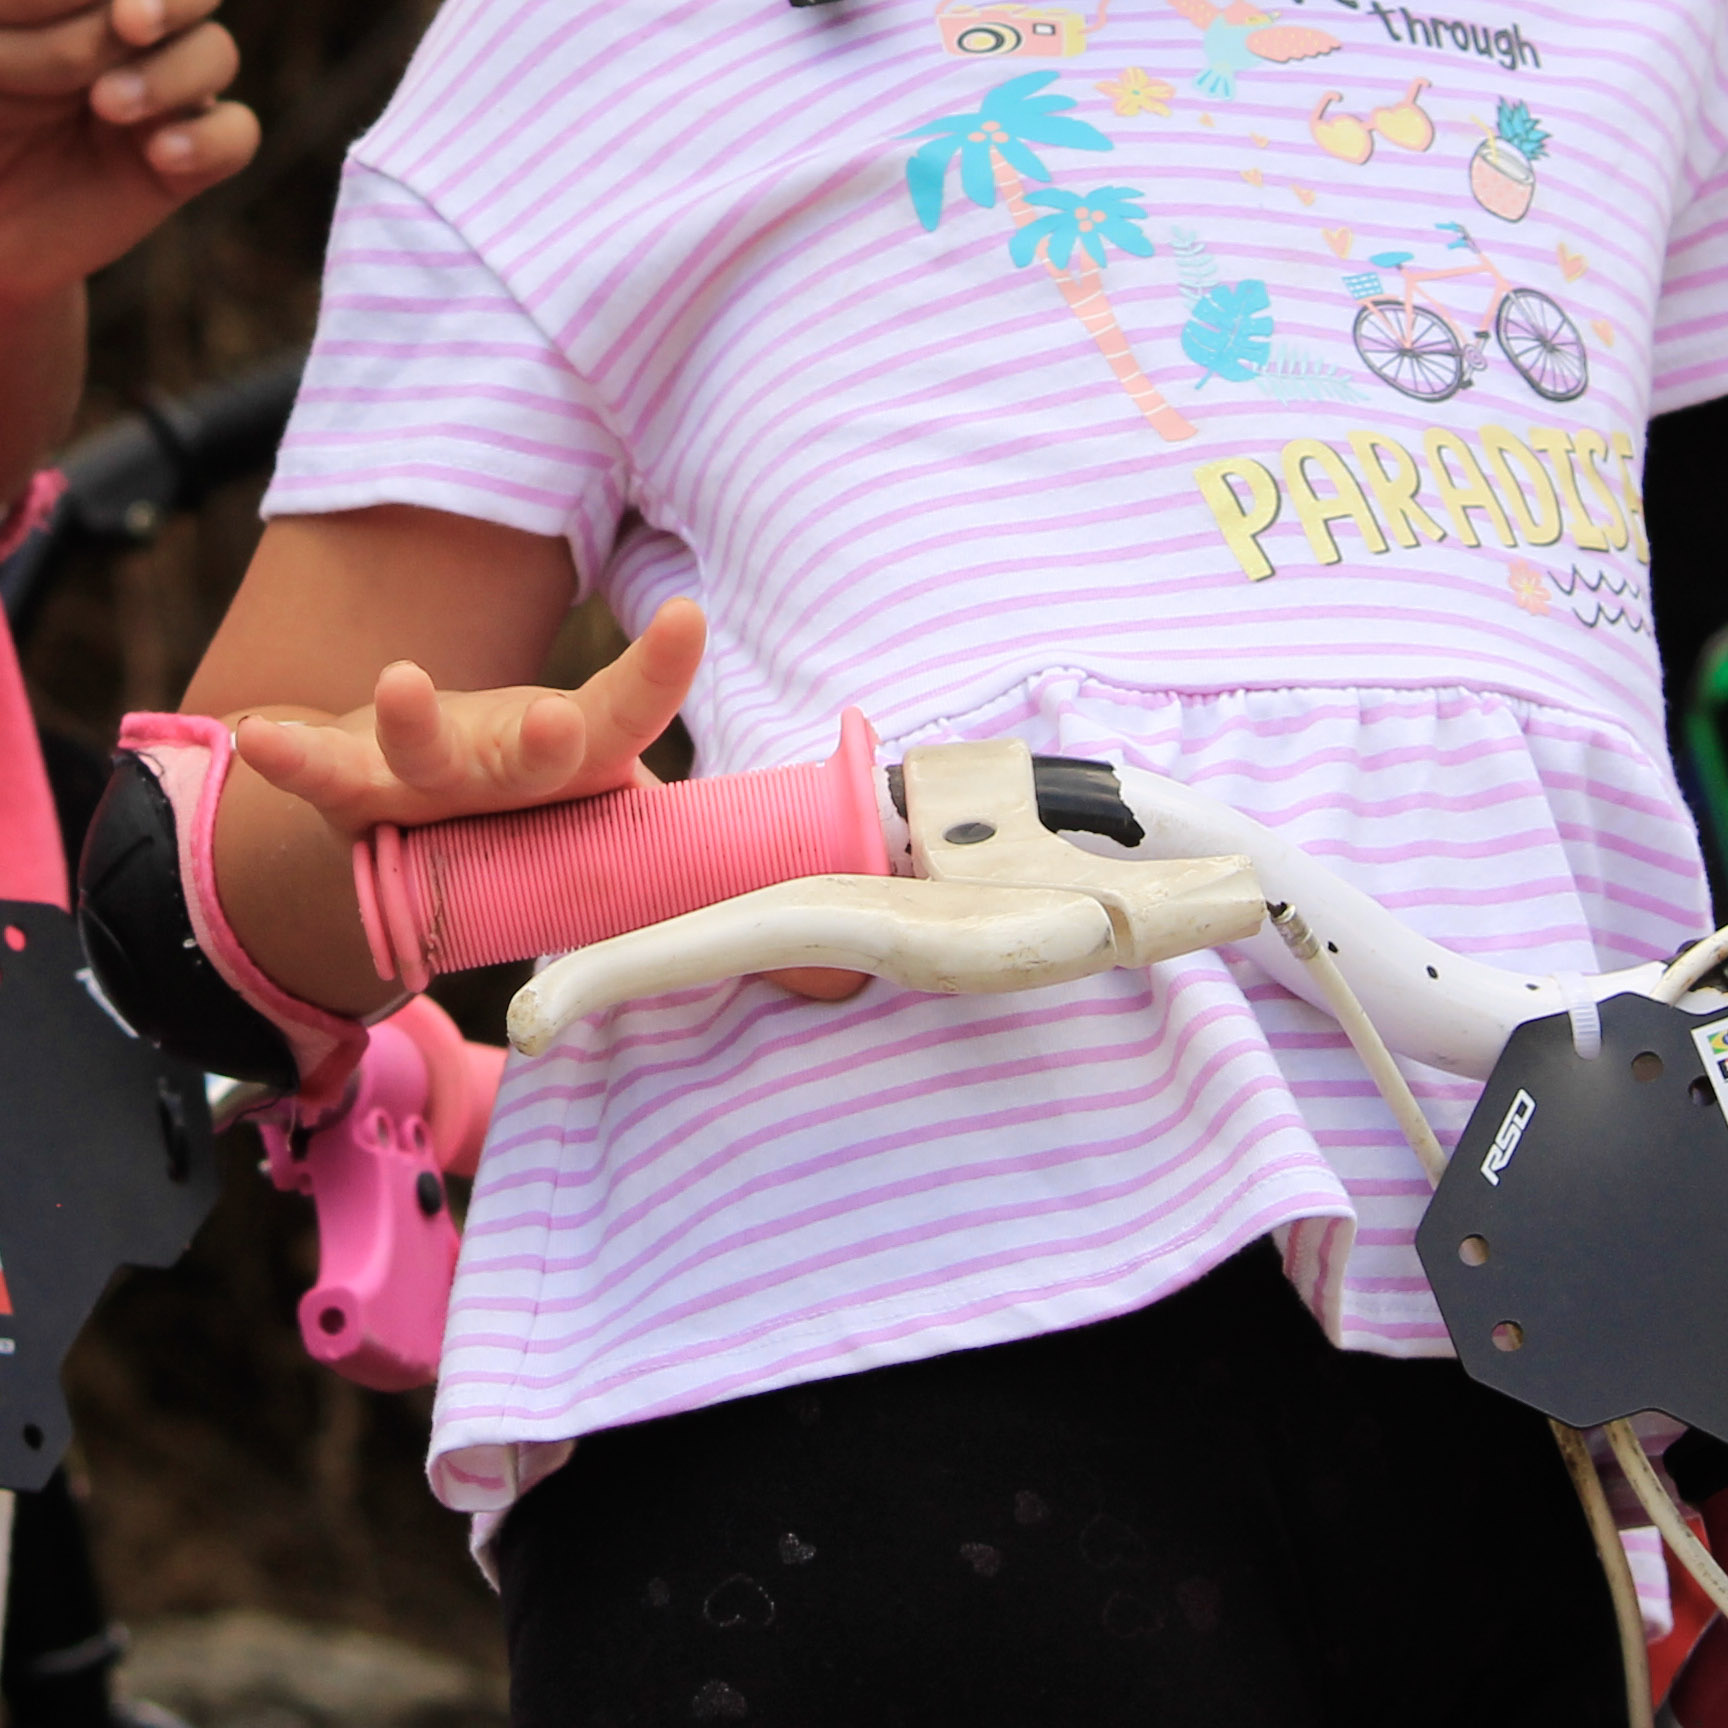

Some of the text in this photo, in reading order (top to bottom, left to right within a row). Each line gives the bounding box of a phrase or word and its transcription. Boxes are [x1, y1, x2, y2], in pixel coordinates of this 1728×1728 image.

[1367, 1, 1542, 70] through
[1193, 424, 1650, 582] PARADISE
[1479, 1088, 1537, 1187] RSD
